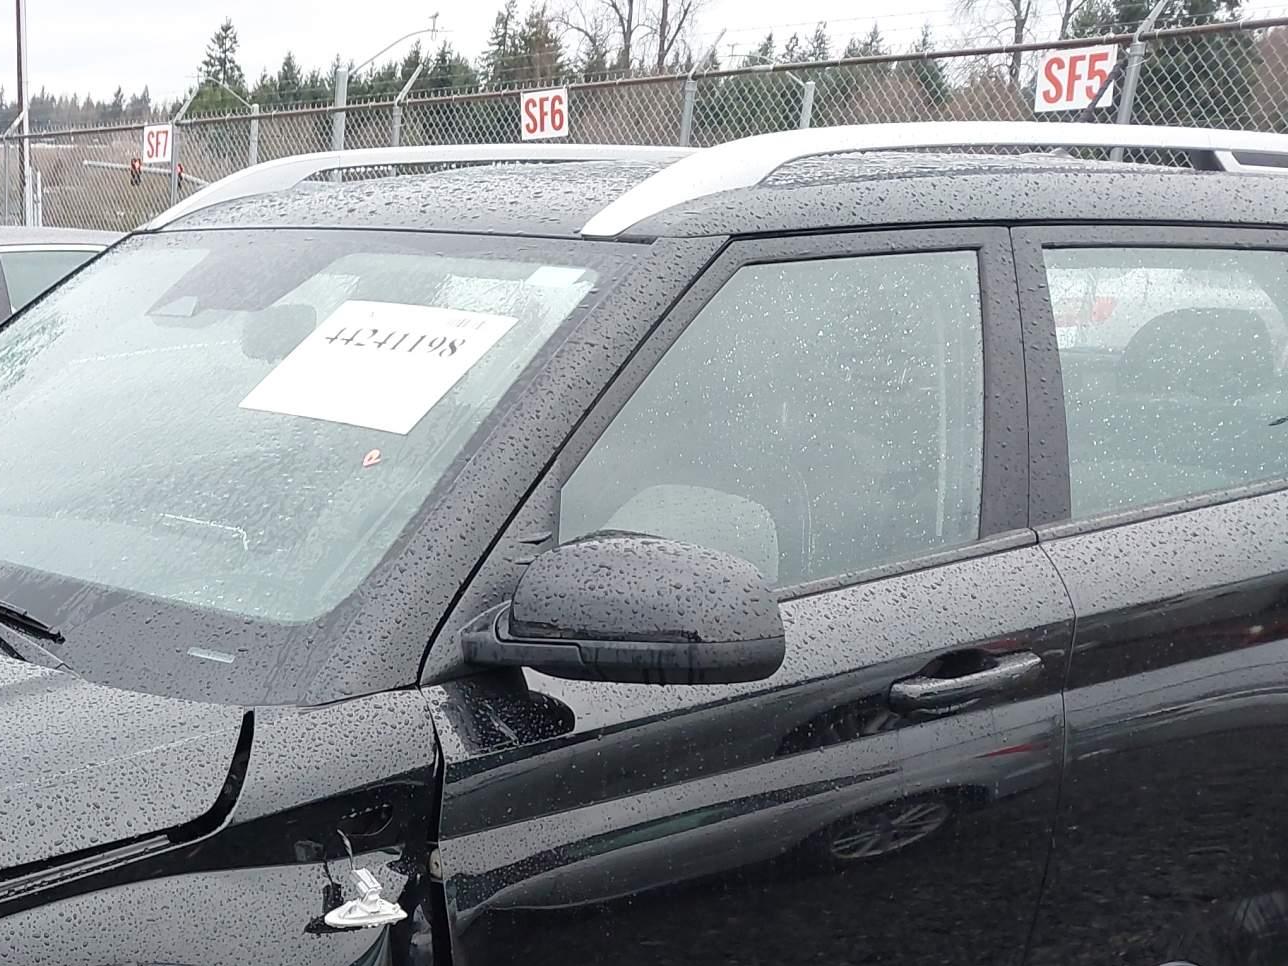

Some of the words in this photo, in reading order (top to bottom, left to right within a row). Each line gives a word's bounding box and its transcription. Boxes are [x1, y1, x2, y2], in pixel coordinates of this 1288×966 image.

[1042, 51, 1109, 105] SF5
[523, 95, 566, 134] SF6
[146, 130, 169, 158] SF7
[325, 327, 466, 357] 44241198
